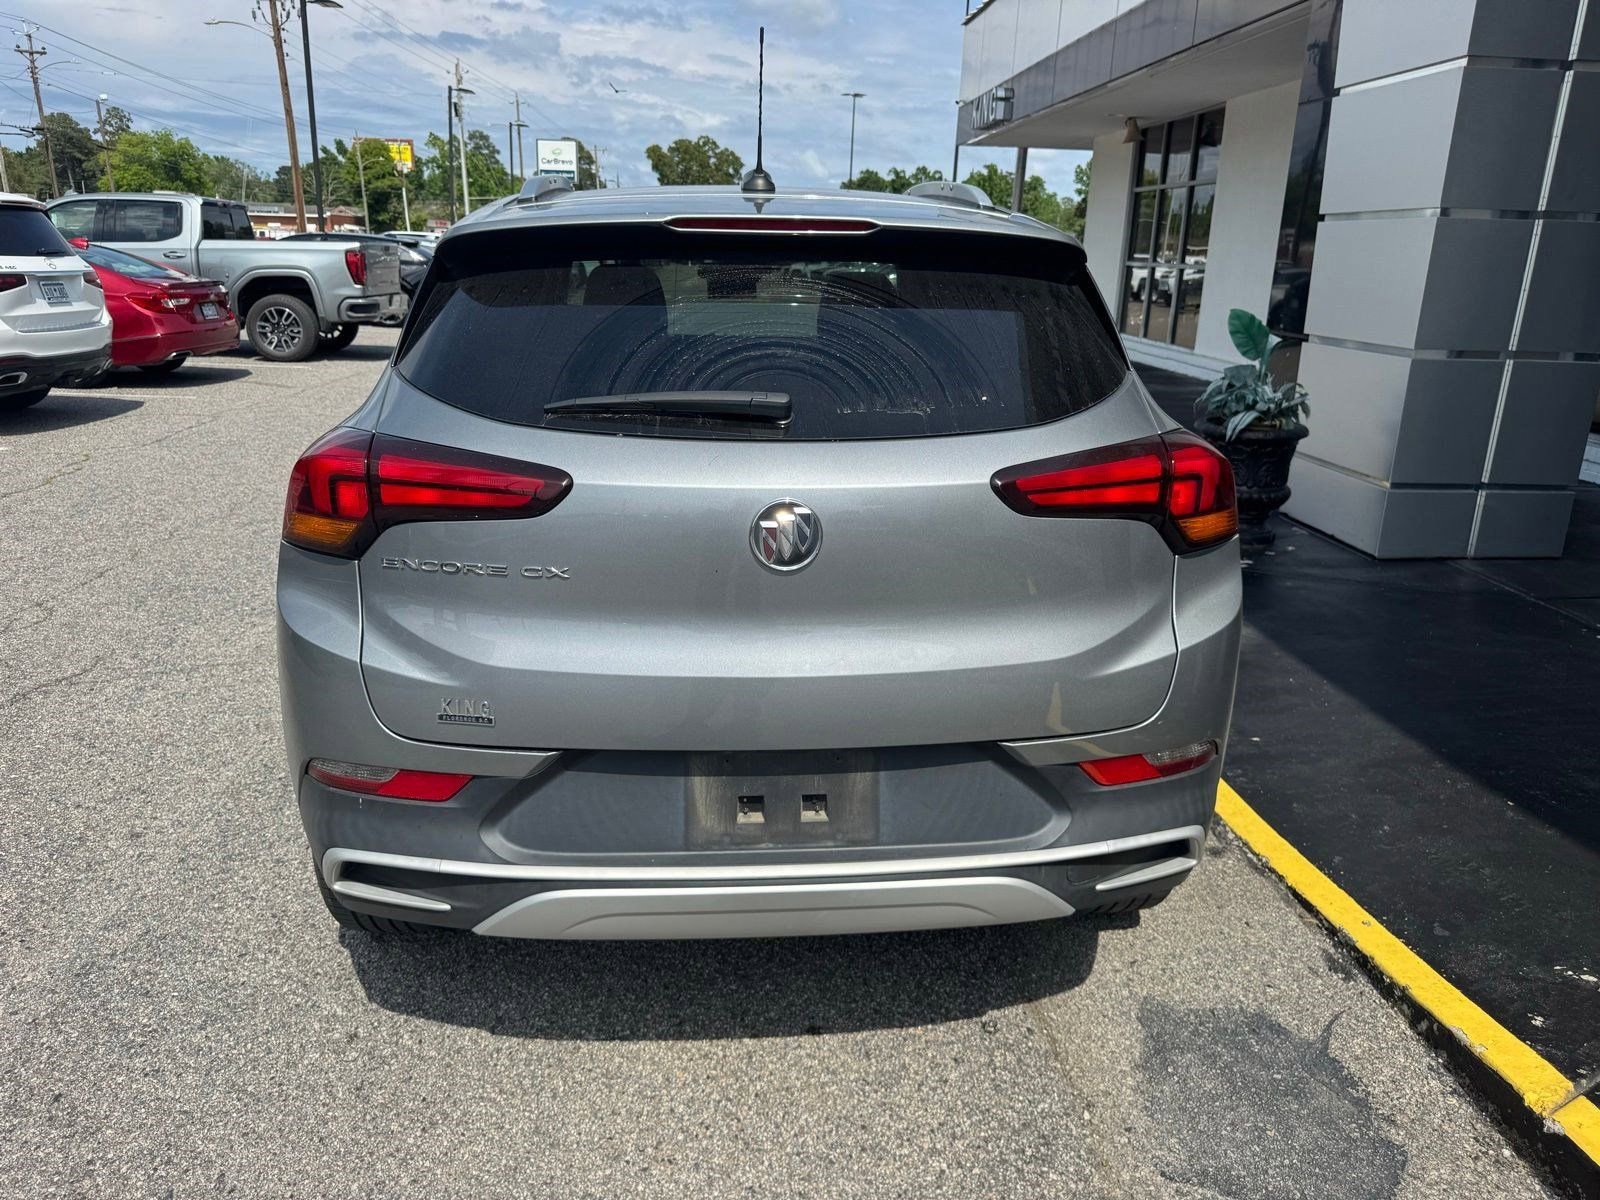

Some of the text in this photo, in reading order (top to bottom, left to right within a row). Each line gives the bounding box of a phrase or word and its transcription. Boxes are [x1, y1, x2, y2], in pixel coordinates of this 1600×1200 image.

[970, 87, 1010, 129] KING
[381, 556, 571, 580] ENCORE GX
[440, 697, 491, 717] KING
